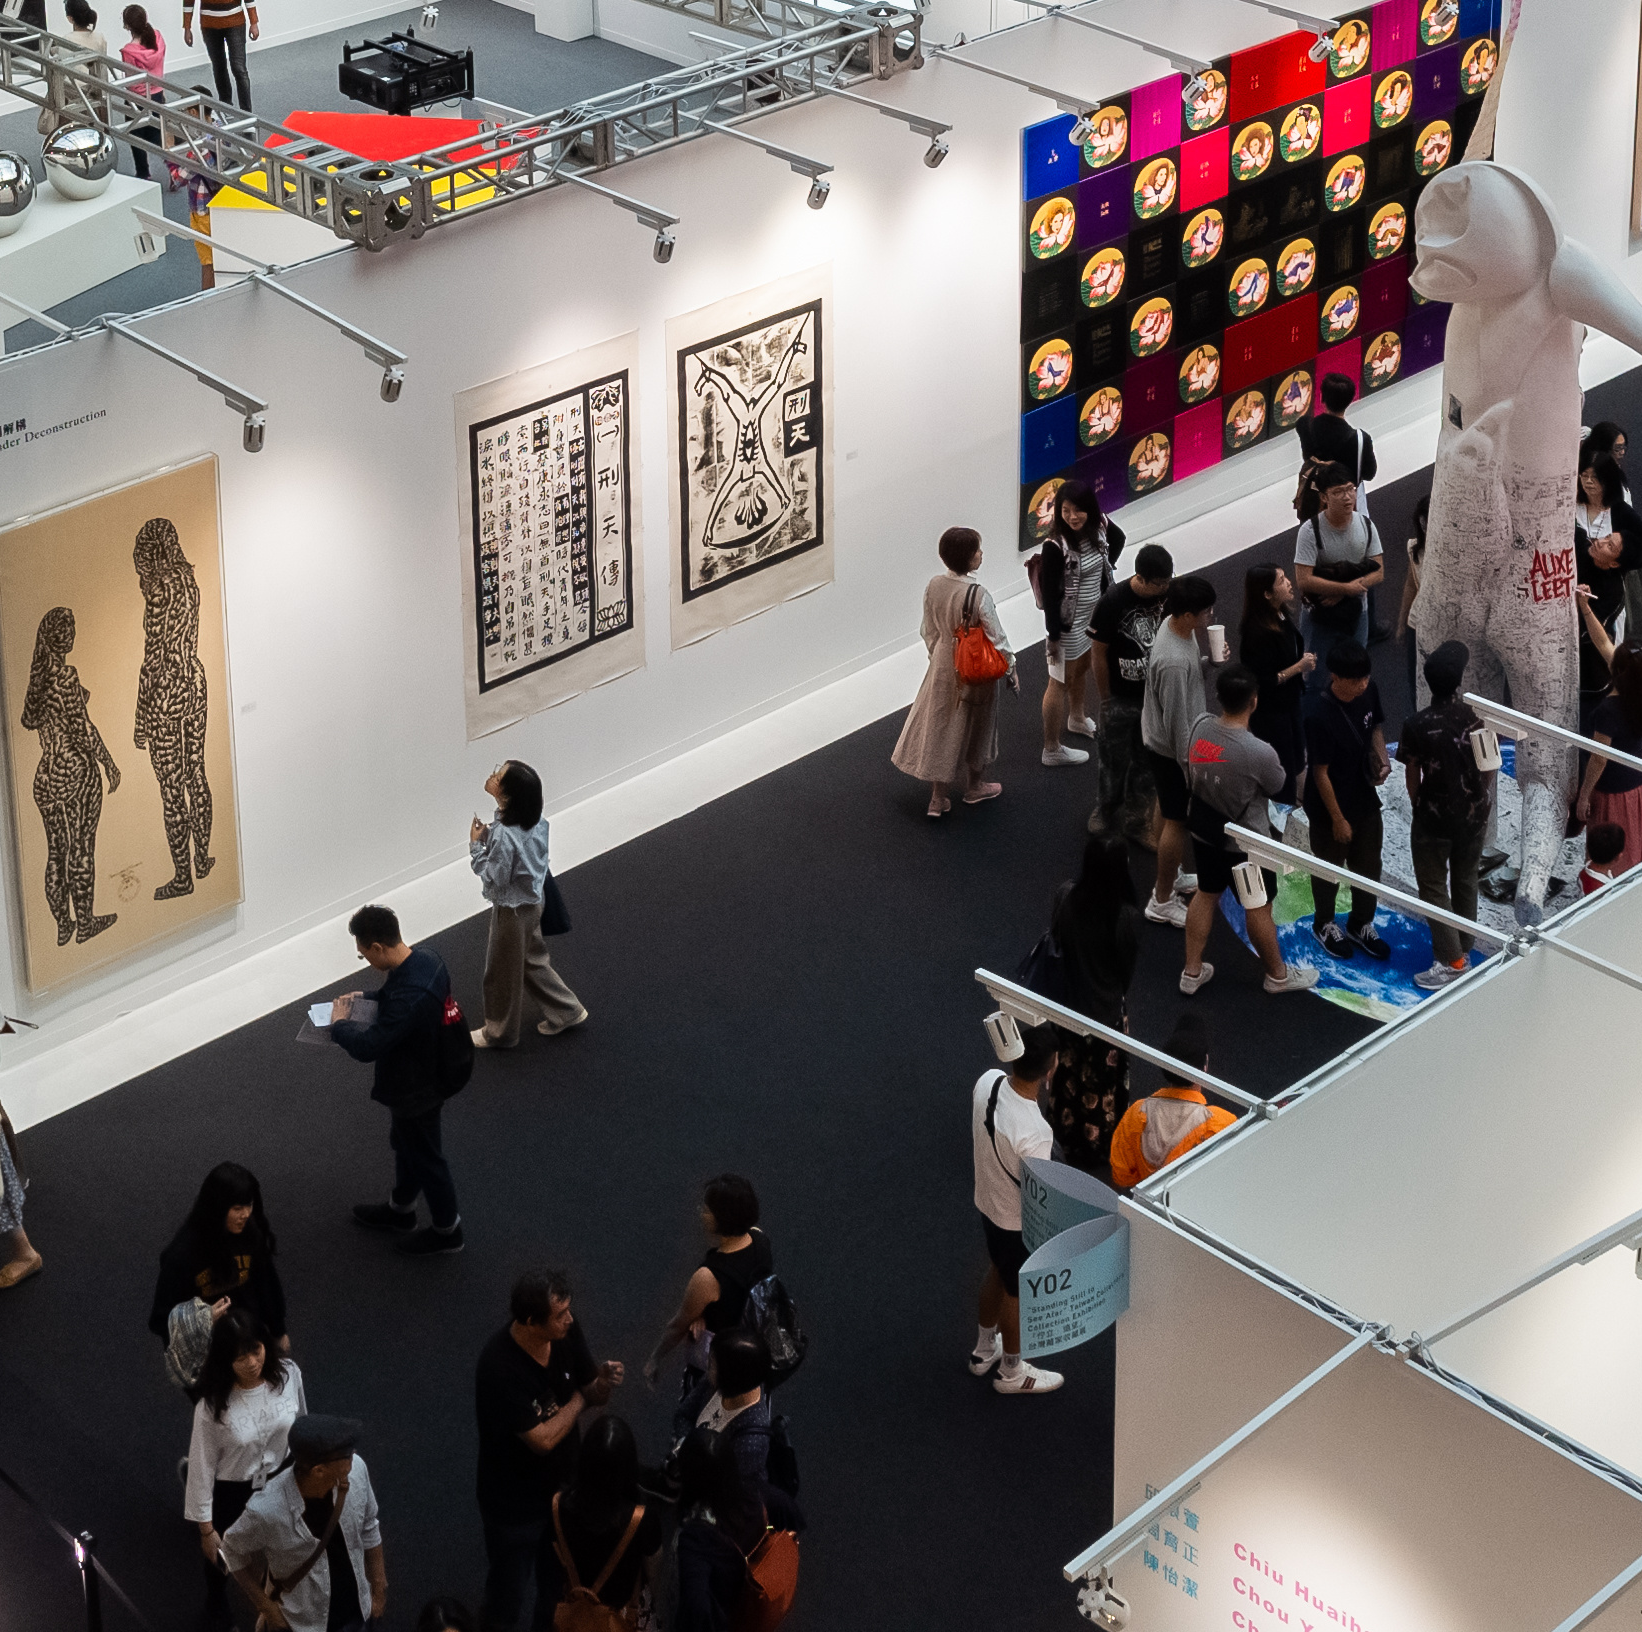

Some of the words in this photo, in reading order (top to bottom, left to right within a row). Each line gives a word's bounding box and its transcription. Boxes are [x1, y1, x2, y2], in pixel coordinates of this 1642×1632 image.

[24, 409, 107, 442] Deconstruction
[1023, 1170, 1048, 1211] Y02
[1026, 1269, 1072, 1298] Y02
[1070, 1290, 1086, 1302] Still
[1027, 1315, 1043, 1324] See
[1070, 1296, 1095, 1312] Taiwan
[1027, 1316, 1070, 1332] Collection
[1232, 1576, 1289, 1625] Chou
[1233, 1541, 1284, 1587] Chiu
[1294, 1580, 1371, 1632] Huaih
